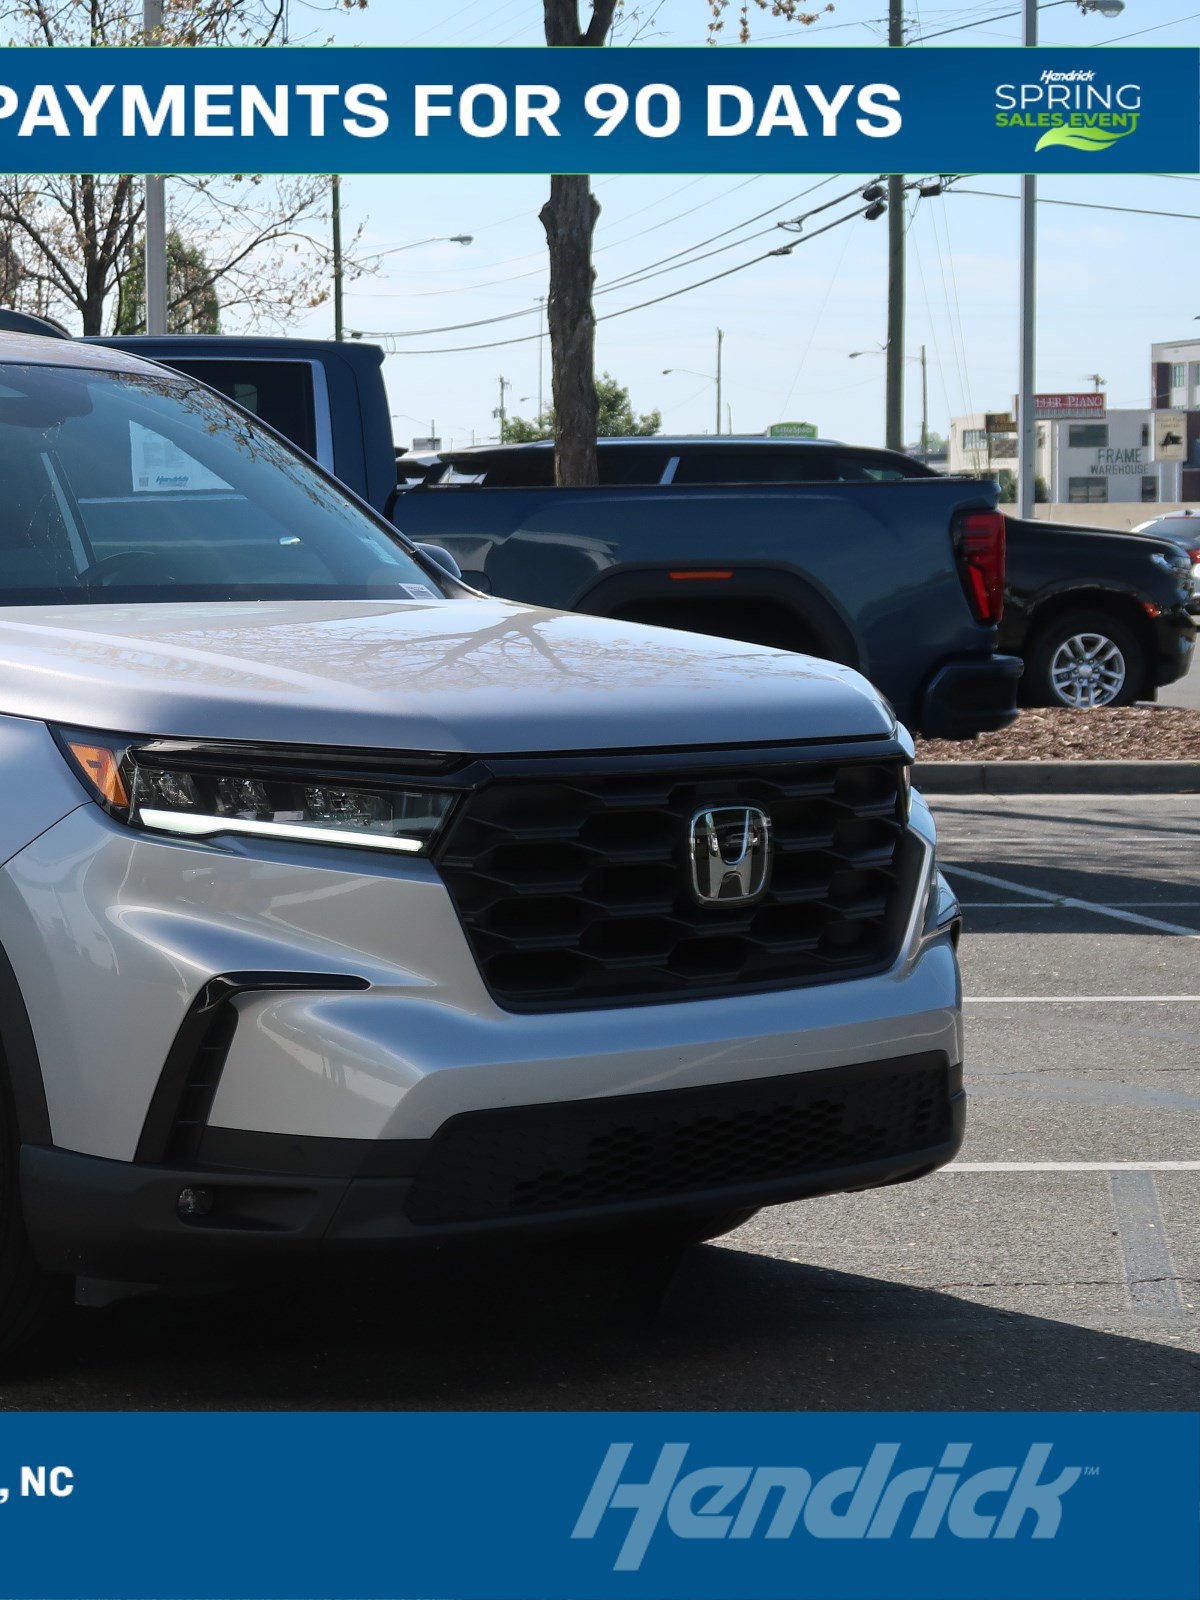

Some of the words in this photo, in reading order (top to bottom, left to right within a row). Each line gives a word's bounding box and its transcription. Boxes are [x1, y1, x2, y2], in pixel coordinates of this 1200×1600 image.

[1067, 395, 1103, 408] PIANO
[1097, 448, 1142, 464] FRAME
[1090, 464, 1150, 475] WAREHOUSE
